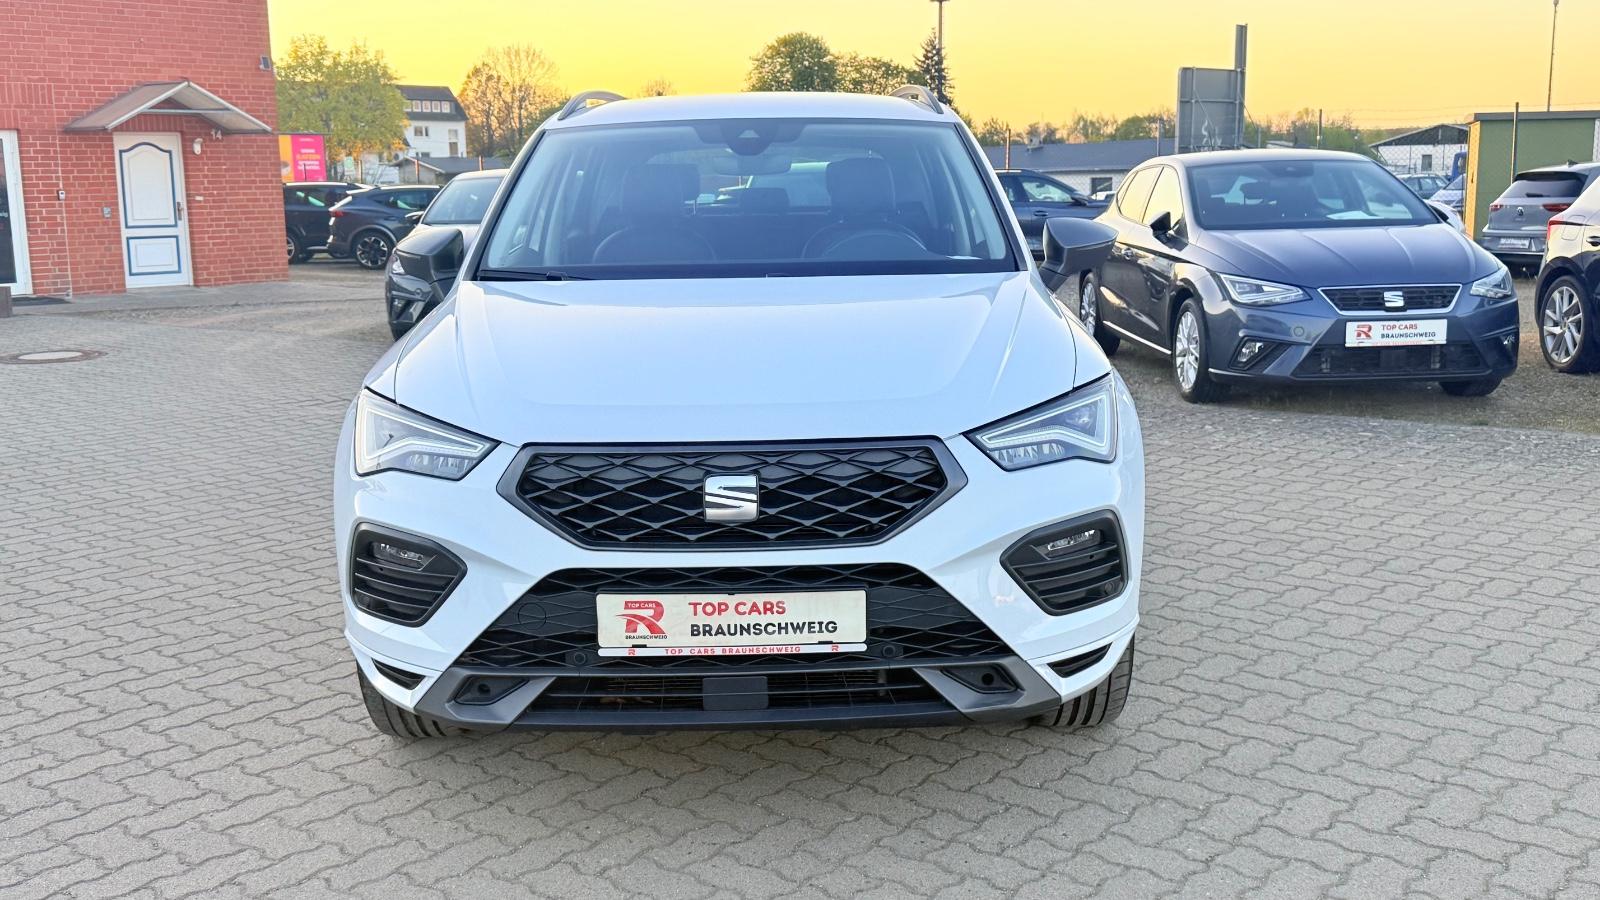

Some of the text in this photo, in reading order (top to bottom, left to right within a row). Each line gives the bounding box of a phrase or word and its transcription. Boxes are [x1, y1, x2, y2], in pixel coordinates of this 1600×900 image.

[211, 128, 222, 140] 14
[1380, 331, 1436, 340] BRAUNSCHWEIG
[688, 600, 786, 617] TOP CARS
[690, 620, 838, 637] BRAUNSCHWEIG
[721, 646, 801, 654] BRAUNSCHWEIG
